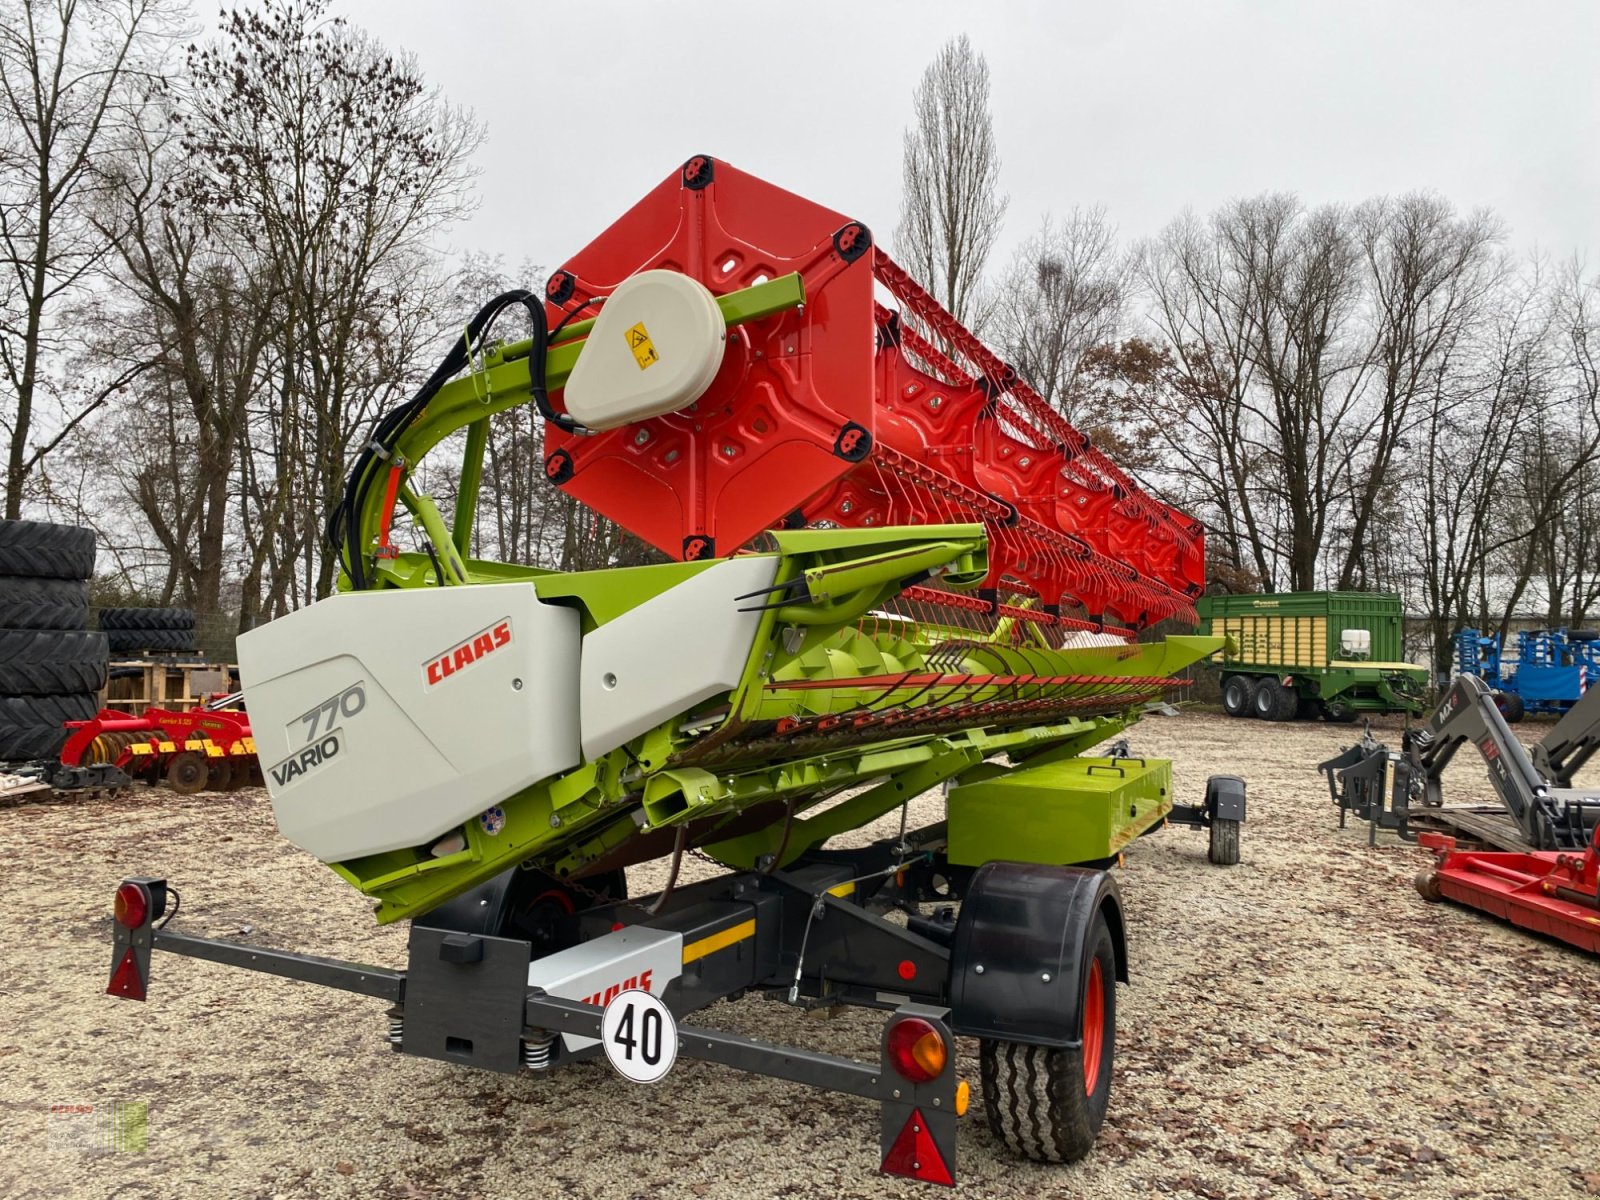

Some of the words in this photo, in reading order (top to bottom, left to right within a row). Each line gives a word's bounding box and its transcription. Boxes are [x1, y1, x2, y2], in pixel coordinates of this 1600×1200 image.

[427, 622, 511, 686] CLAAS
[302, 686, 366, 742] 770
[271, 736, 339, 786] VARIO
[614, 1003, 663, 1066] 40
